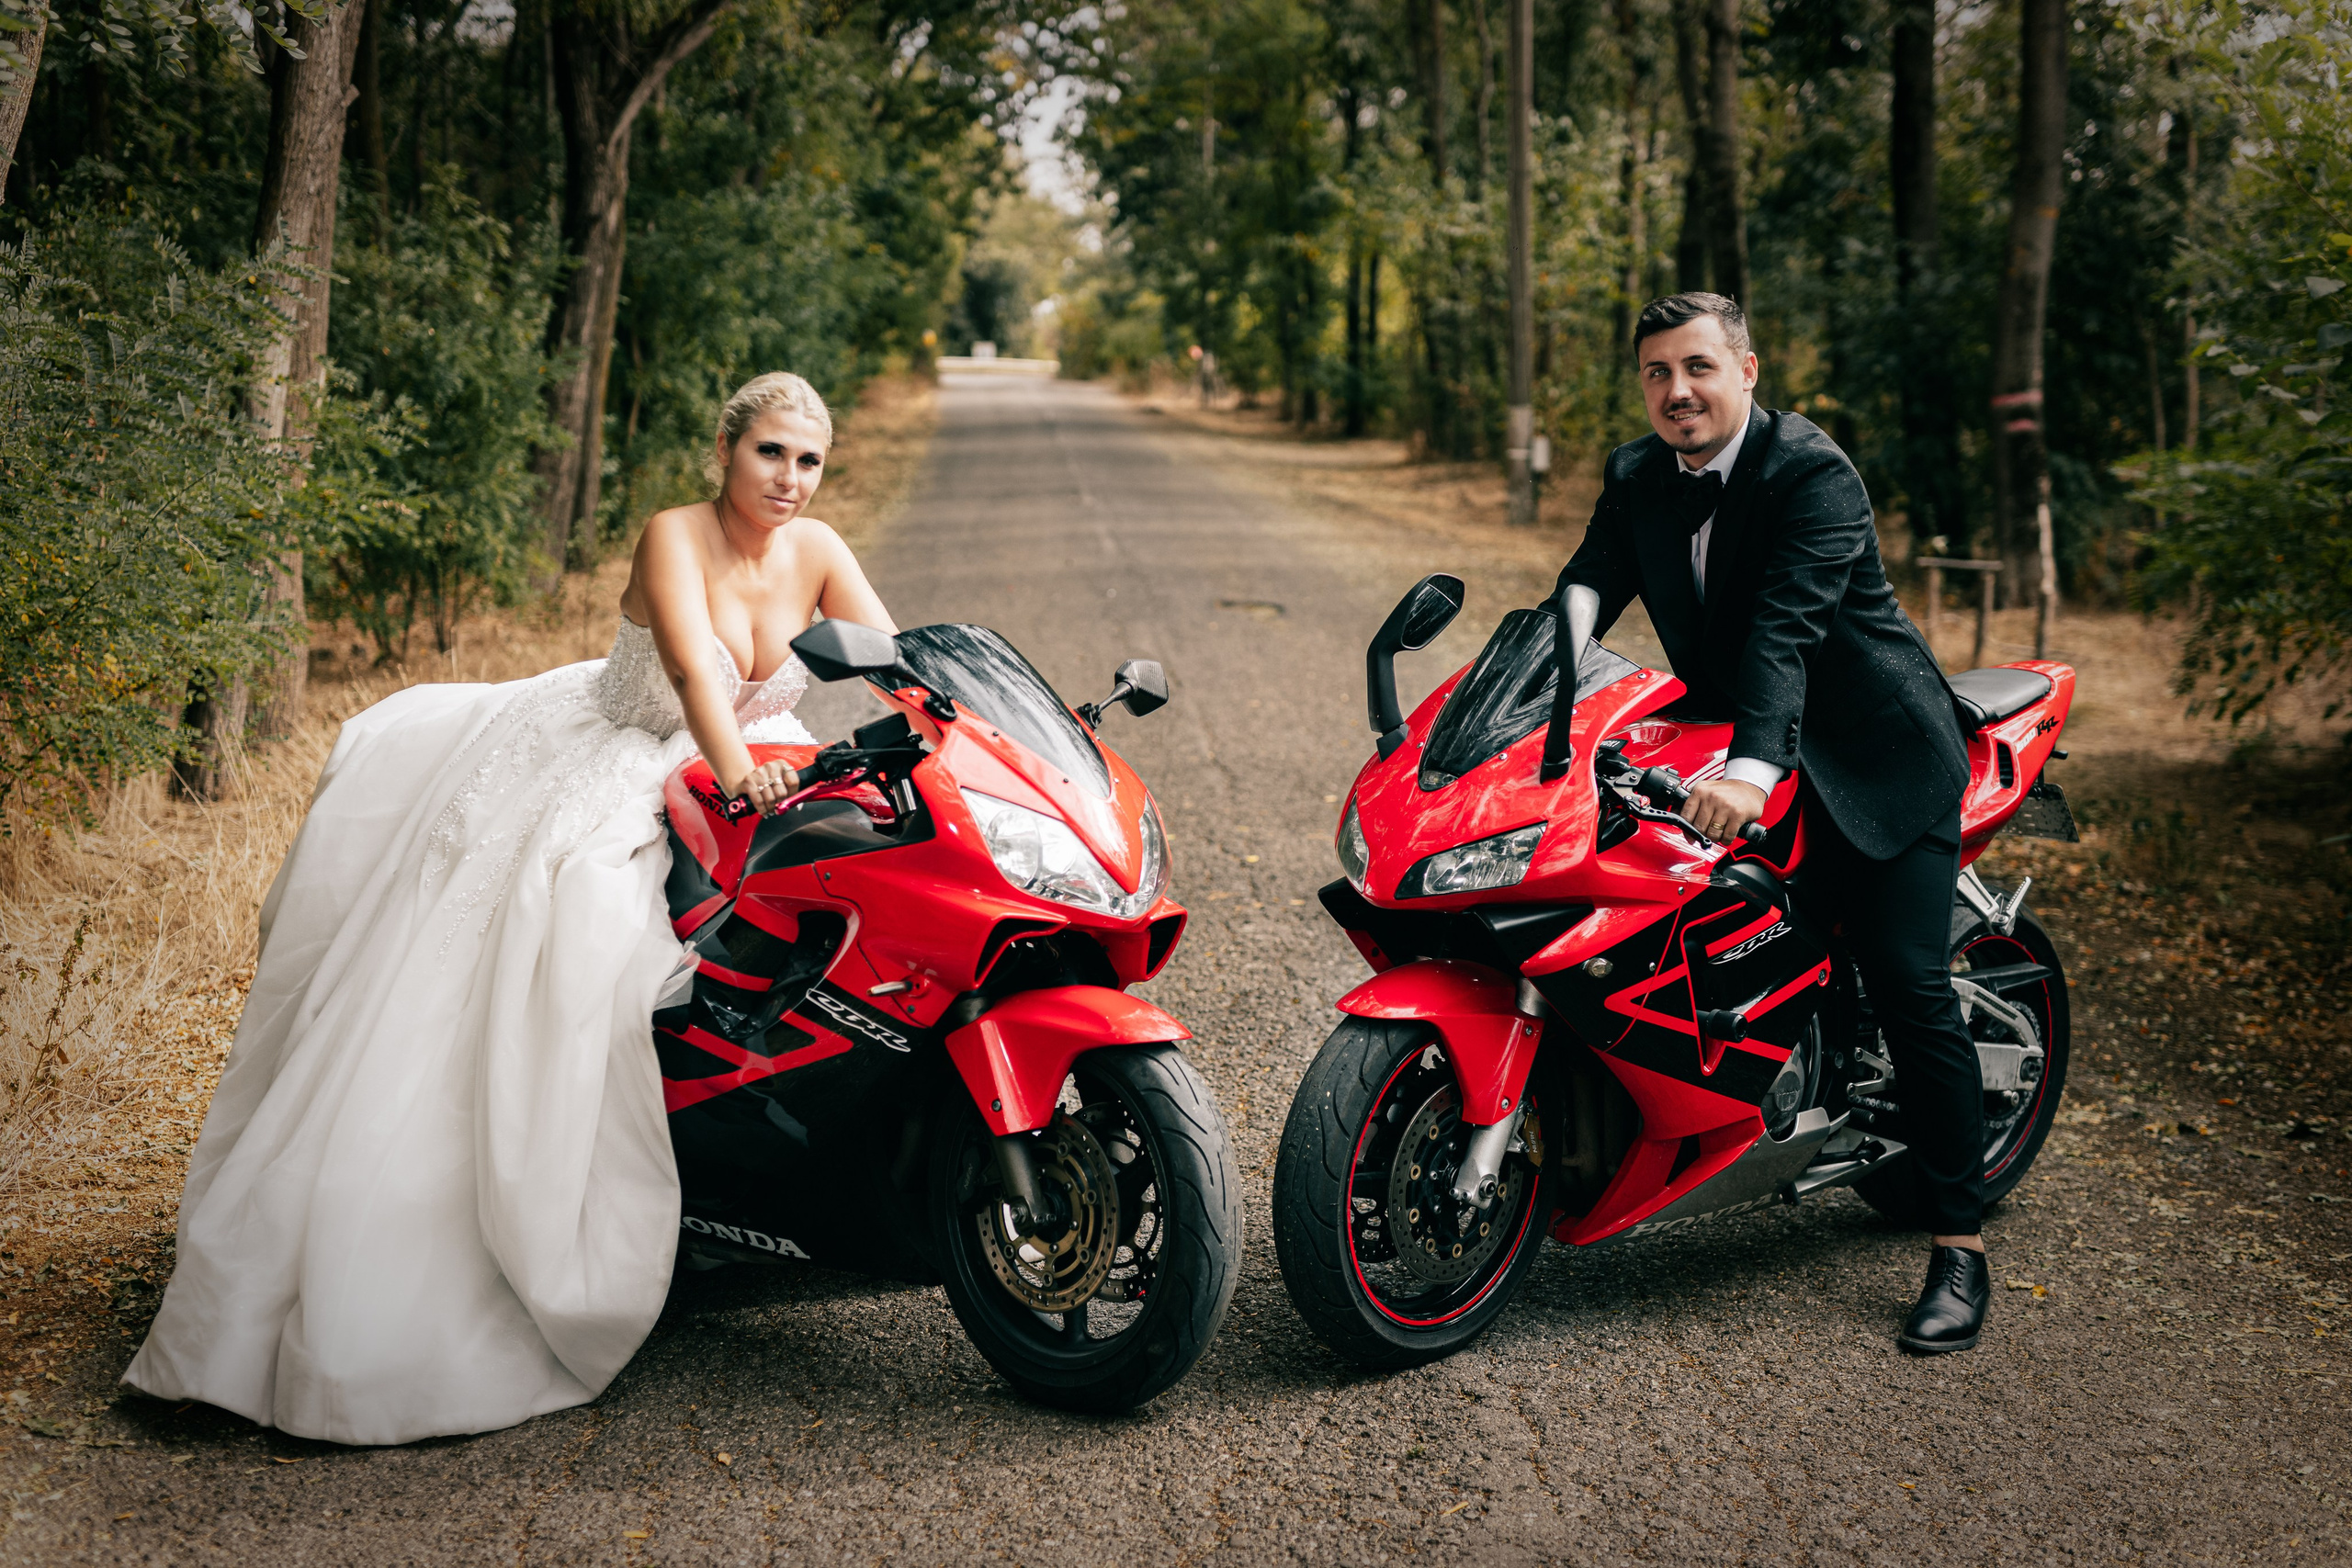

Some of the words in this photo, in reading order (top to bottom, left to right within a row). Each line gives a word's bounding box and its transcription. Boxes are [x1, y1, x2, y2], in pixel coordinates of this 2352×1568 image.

[1709, 921, 1792, 965] CBR
[806, 987, 911, 1053] CBR
[1624, 1192, 1772, 1238] HONDA
[680, 1216, 811, 1260] ONDA
